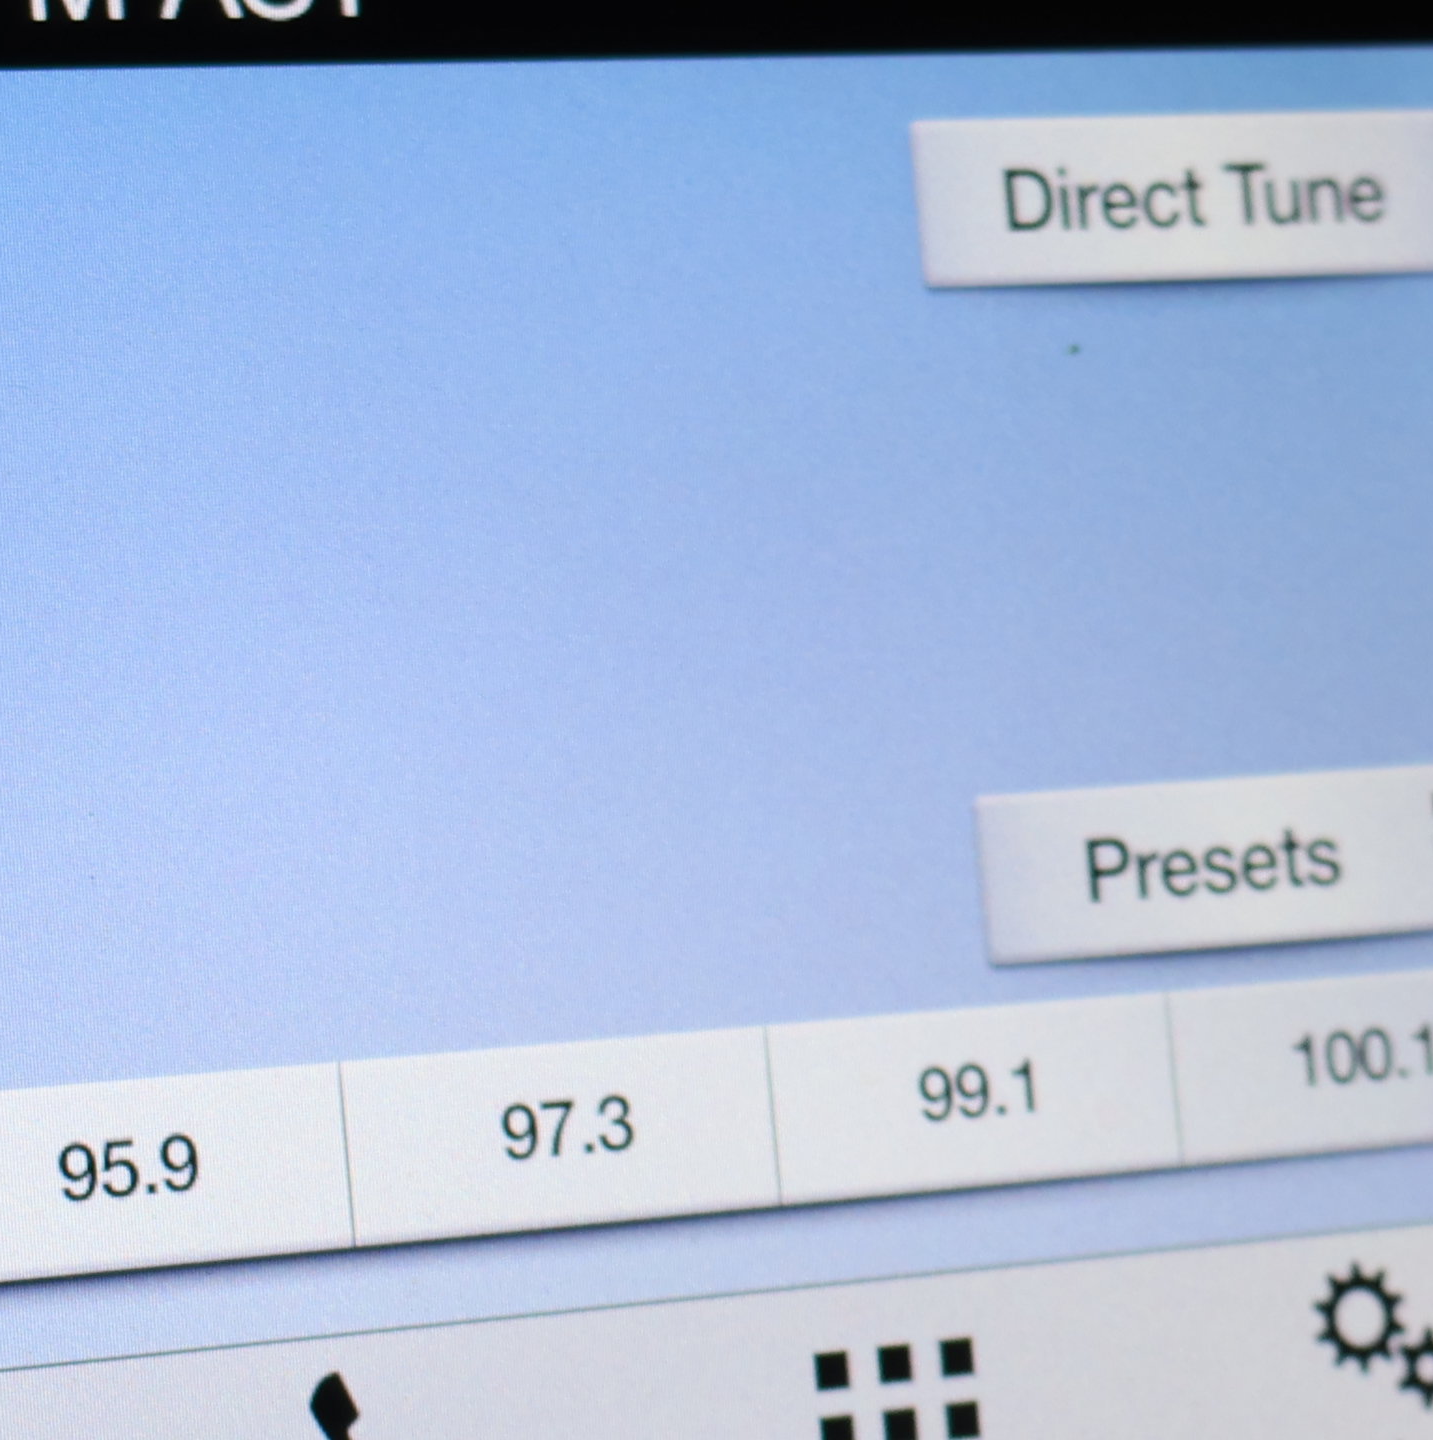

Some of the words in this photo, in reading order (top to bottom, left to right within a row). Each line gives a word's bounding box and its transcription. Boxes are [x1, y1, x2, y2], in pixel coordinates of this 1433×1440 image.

[1003, 165, 1205, 234] Direct
[1223, 162, 1386, 227] Tune
[1085, 829, 1343, 903] Presets
[501, 1094, 636, 1161] 97.3
[917, 1060, 1041, 1125] 99.1
[55, 1132, 201, 1204] 95.9
